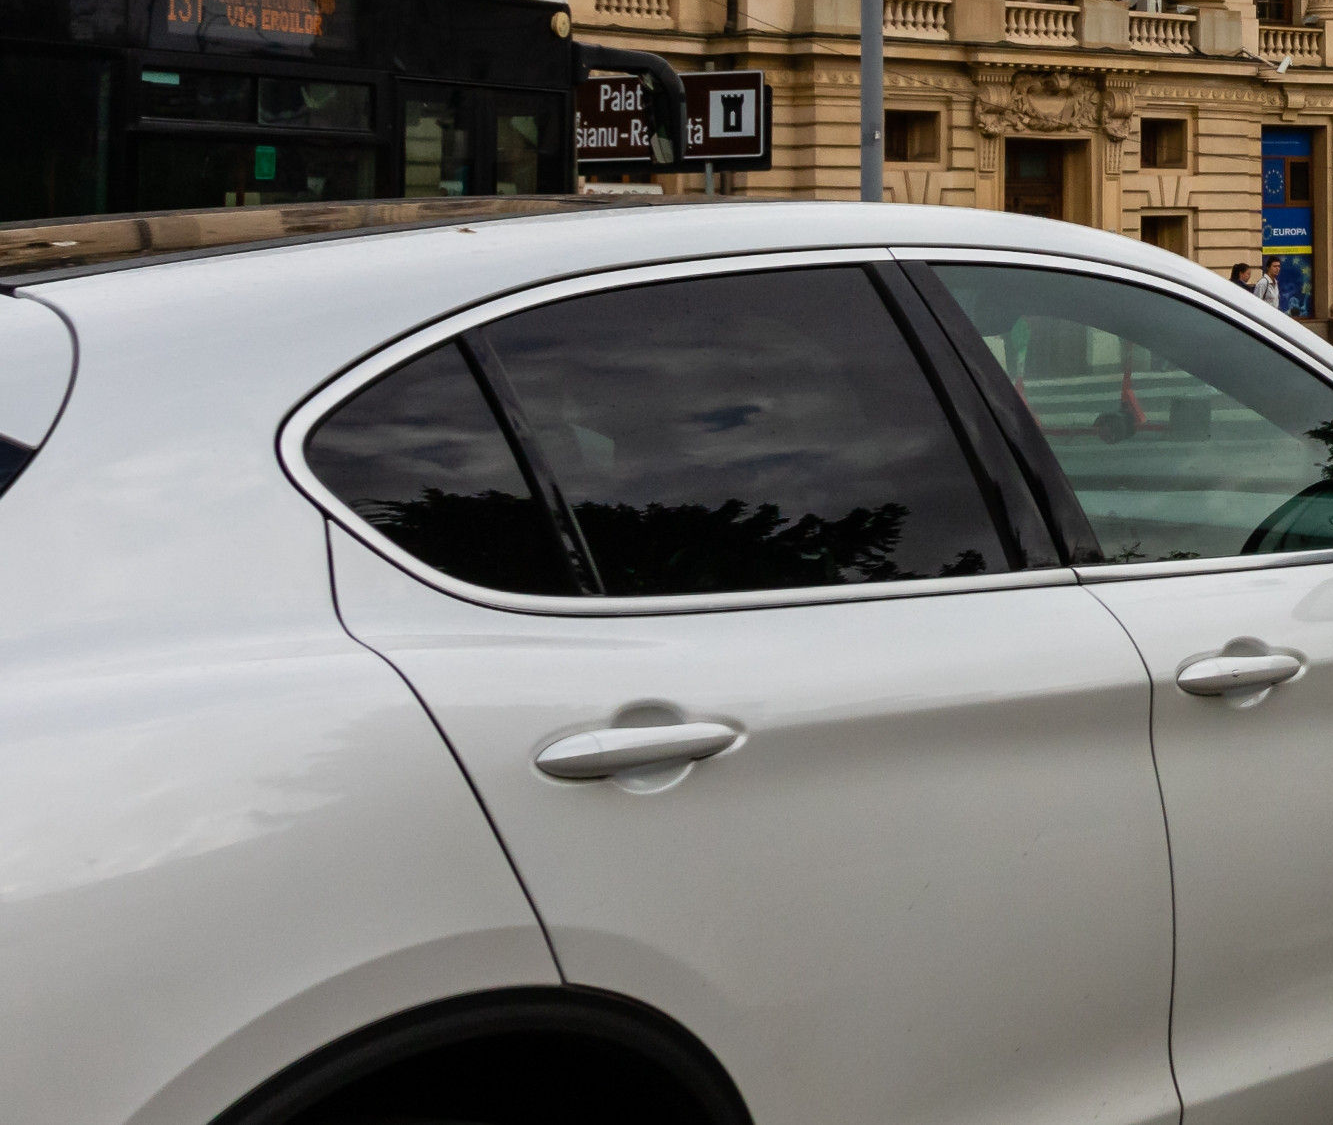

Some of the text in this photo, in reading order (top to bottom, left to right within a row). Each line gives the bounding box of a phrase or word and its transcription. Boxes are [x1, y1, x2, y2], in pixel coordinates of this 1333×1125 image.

[226, 4, 322, 36] VIA EROILOR
[600, 83, 644, 112] Palat
[1273, 227, 1307, 236] EUROPA
